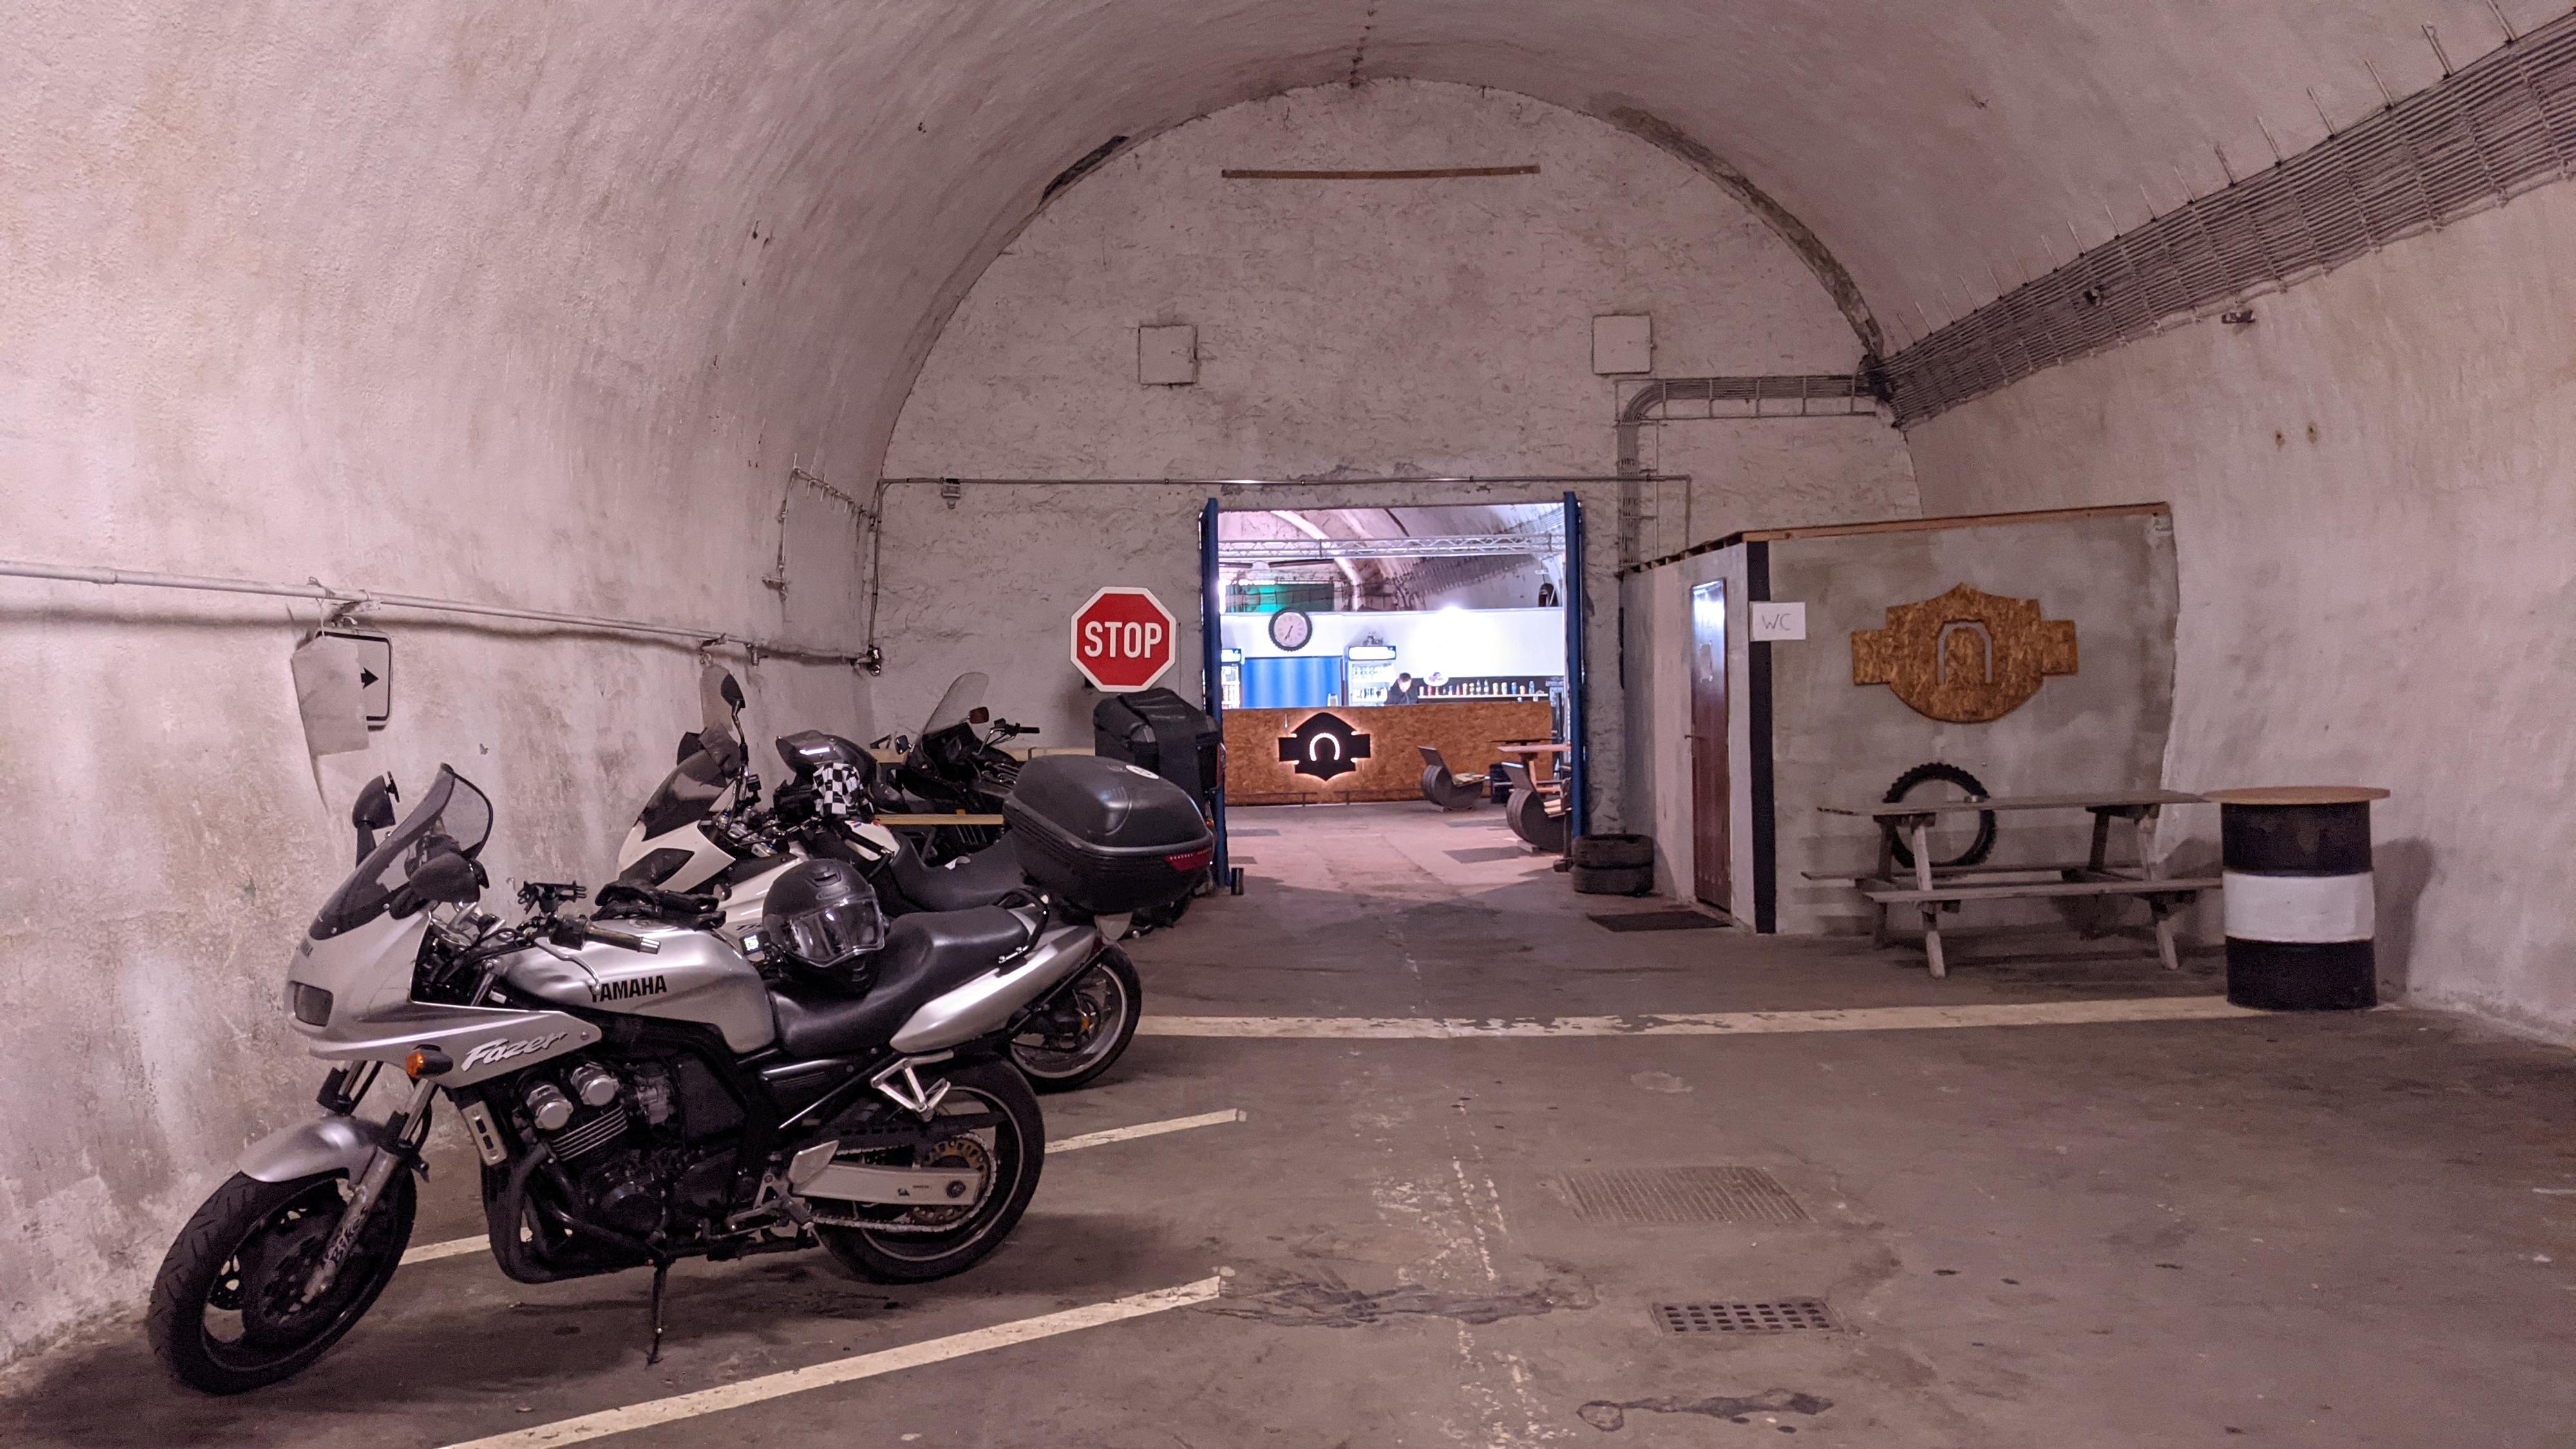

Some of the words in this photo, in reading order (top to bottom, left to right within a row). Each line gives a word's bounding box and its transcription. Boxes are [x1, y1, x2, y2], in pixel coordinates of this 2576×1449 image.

[1761, 612, 1792, 631] WC
[1084, 621, 1162, 658] STOP
[587, 975, 667, 1003] YAMAHA
[460, 1031, 567, 1072] Fazer
